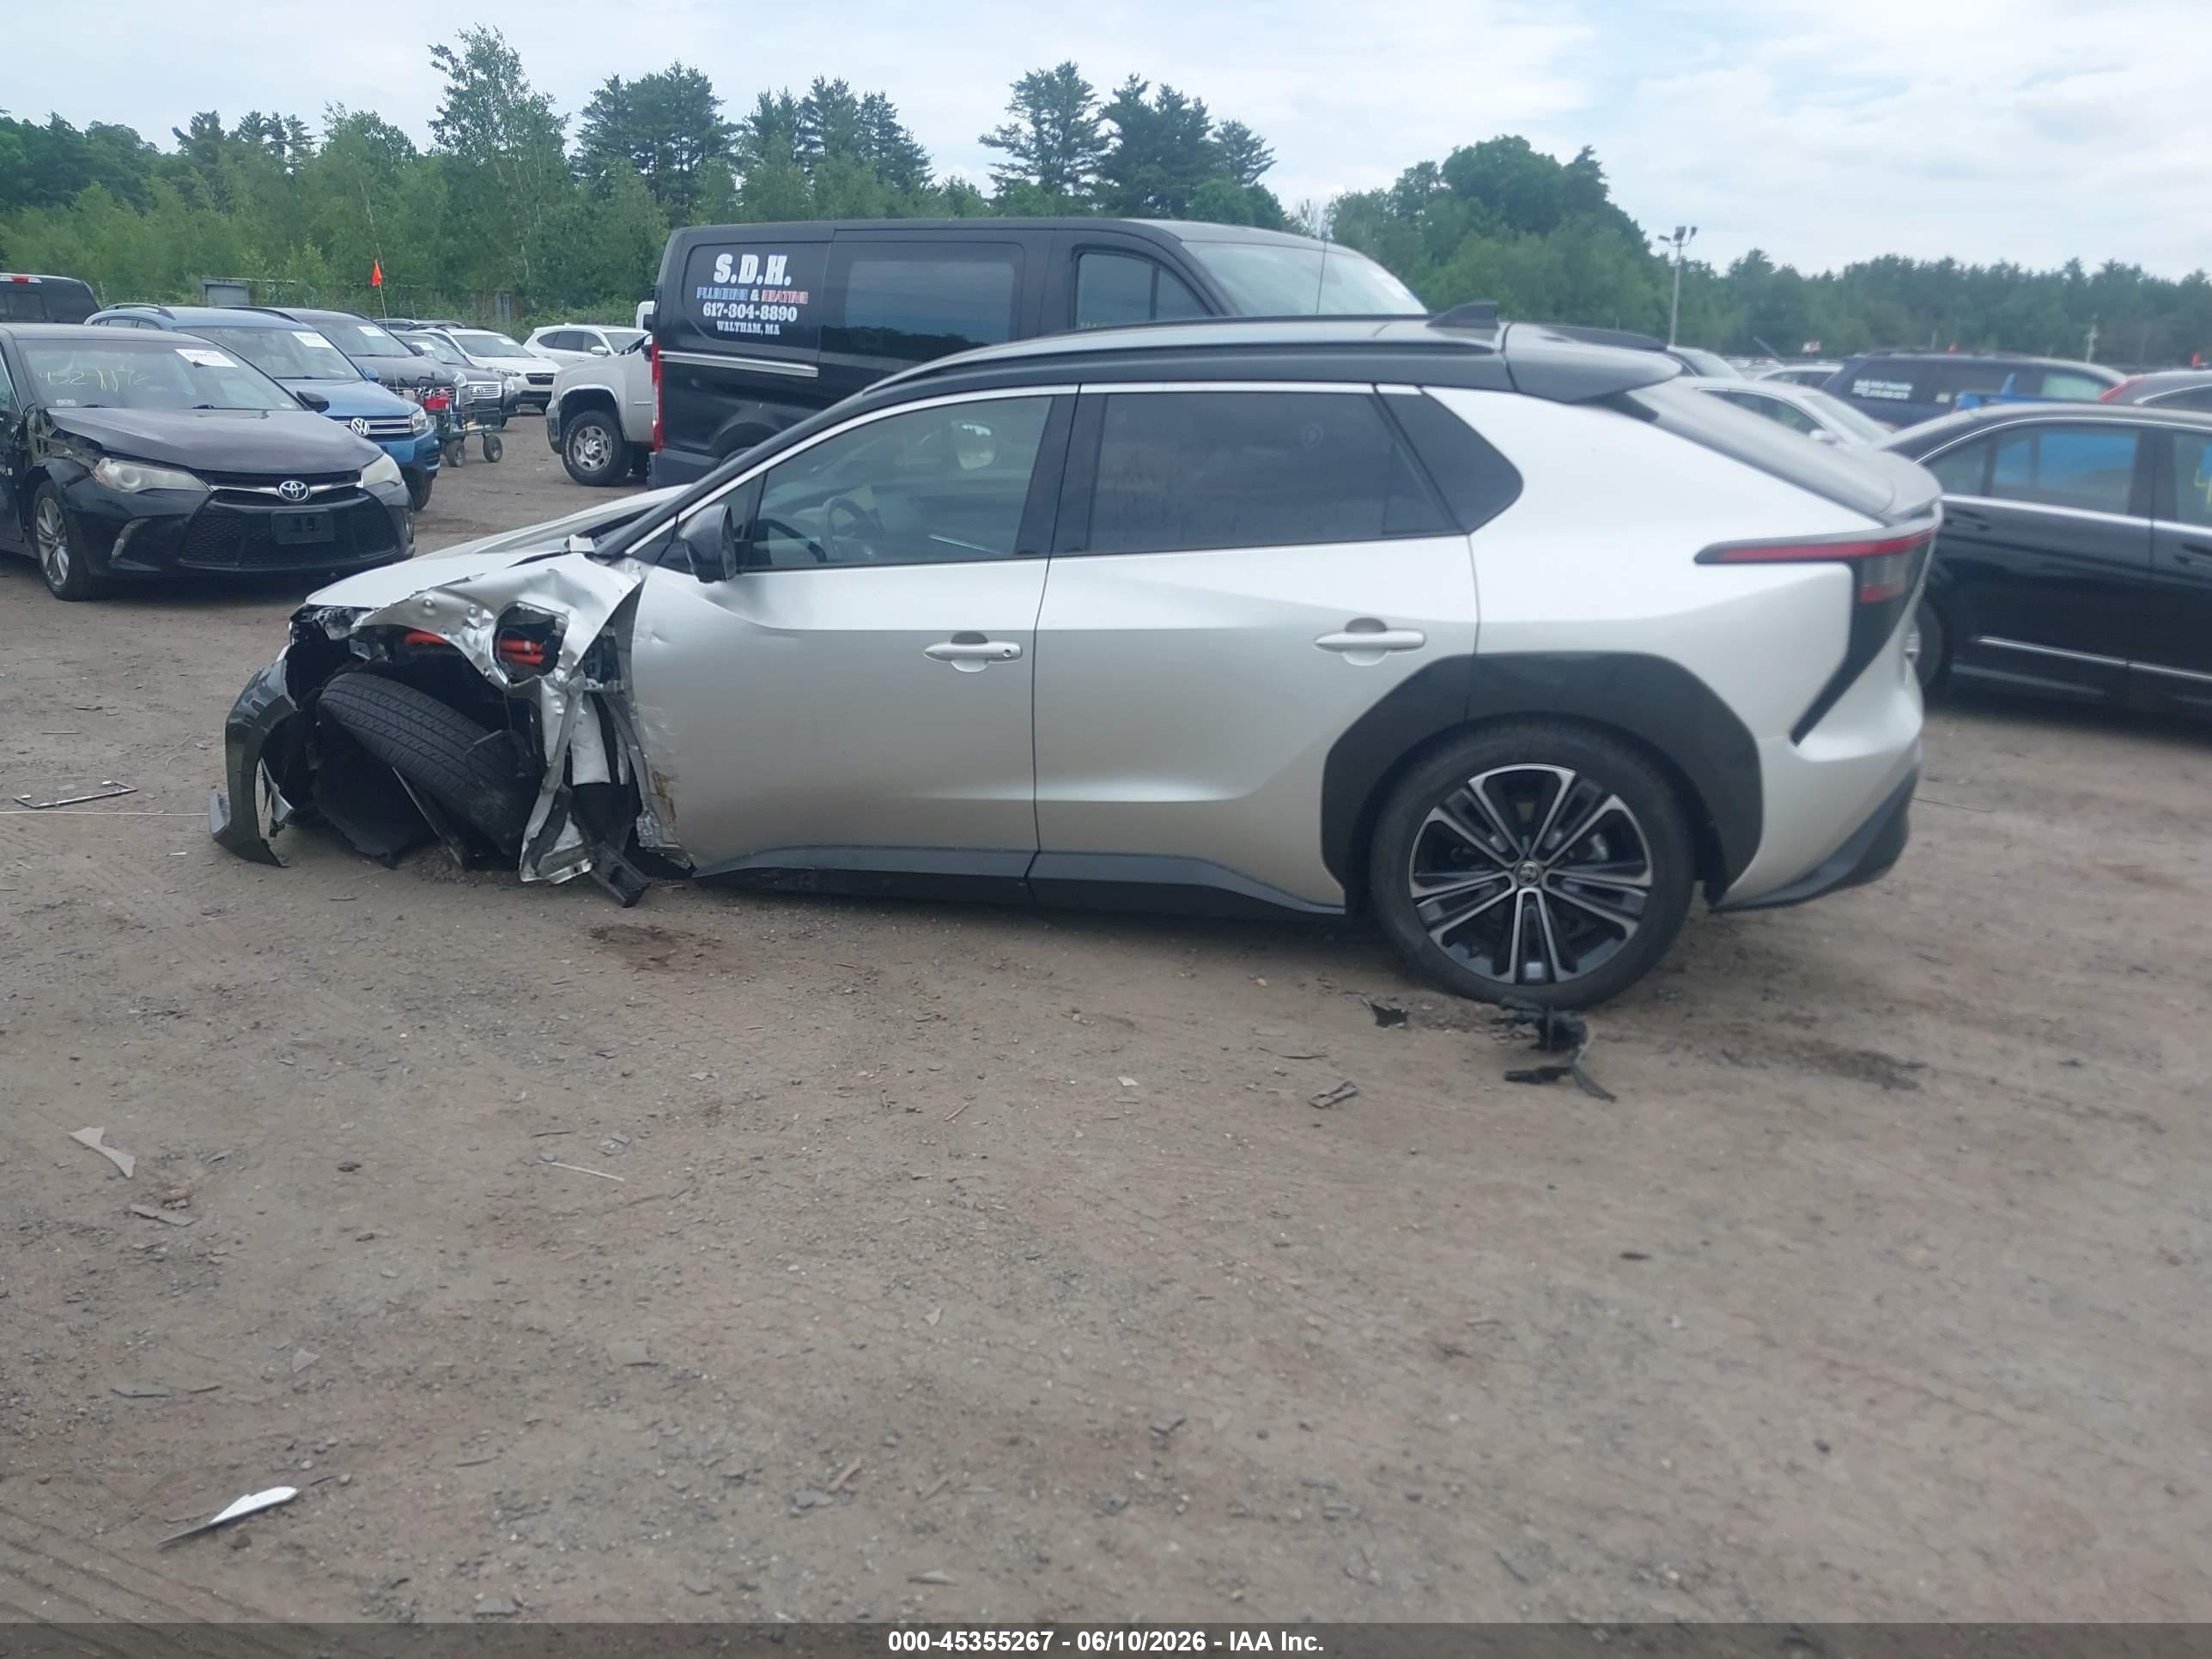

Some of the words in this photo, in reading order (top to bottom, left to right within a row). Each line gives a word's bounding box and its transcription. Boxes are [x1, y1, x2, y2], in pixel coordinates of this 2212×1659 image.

[714, 253, 792, 286] S.D.H.
[750, 289, 759, 301] &
[761, 289, 809, 304] HEATING
[716, 321, 763, 336] WALTHAM,
[764, 324, 780, 335] MA
